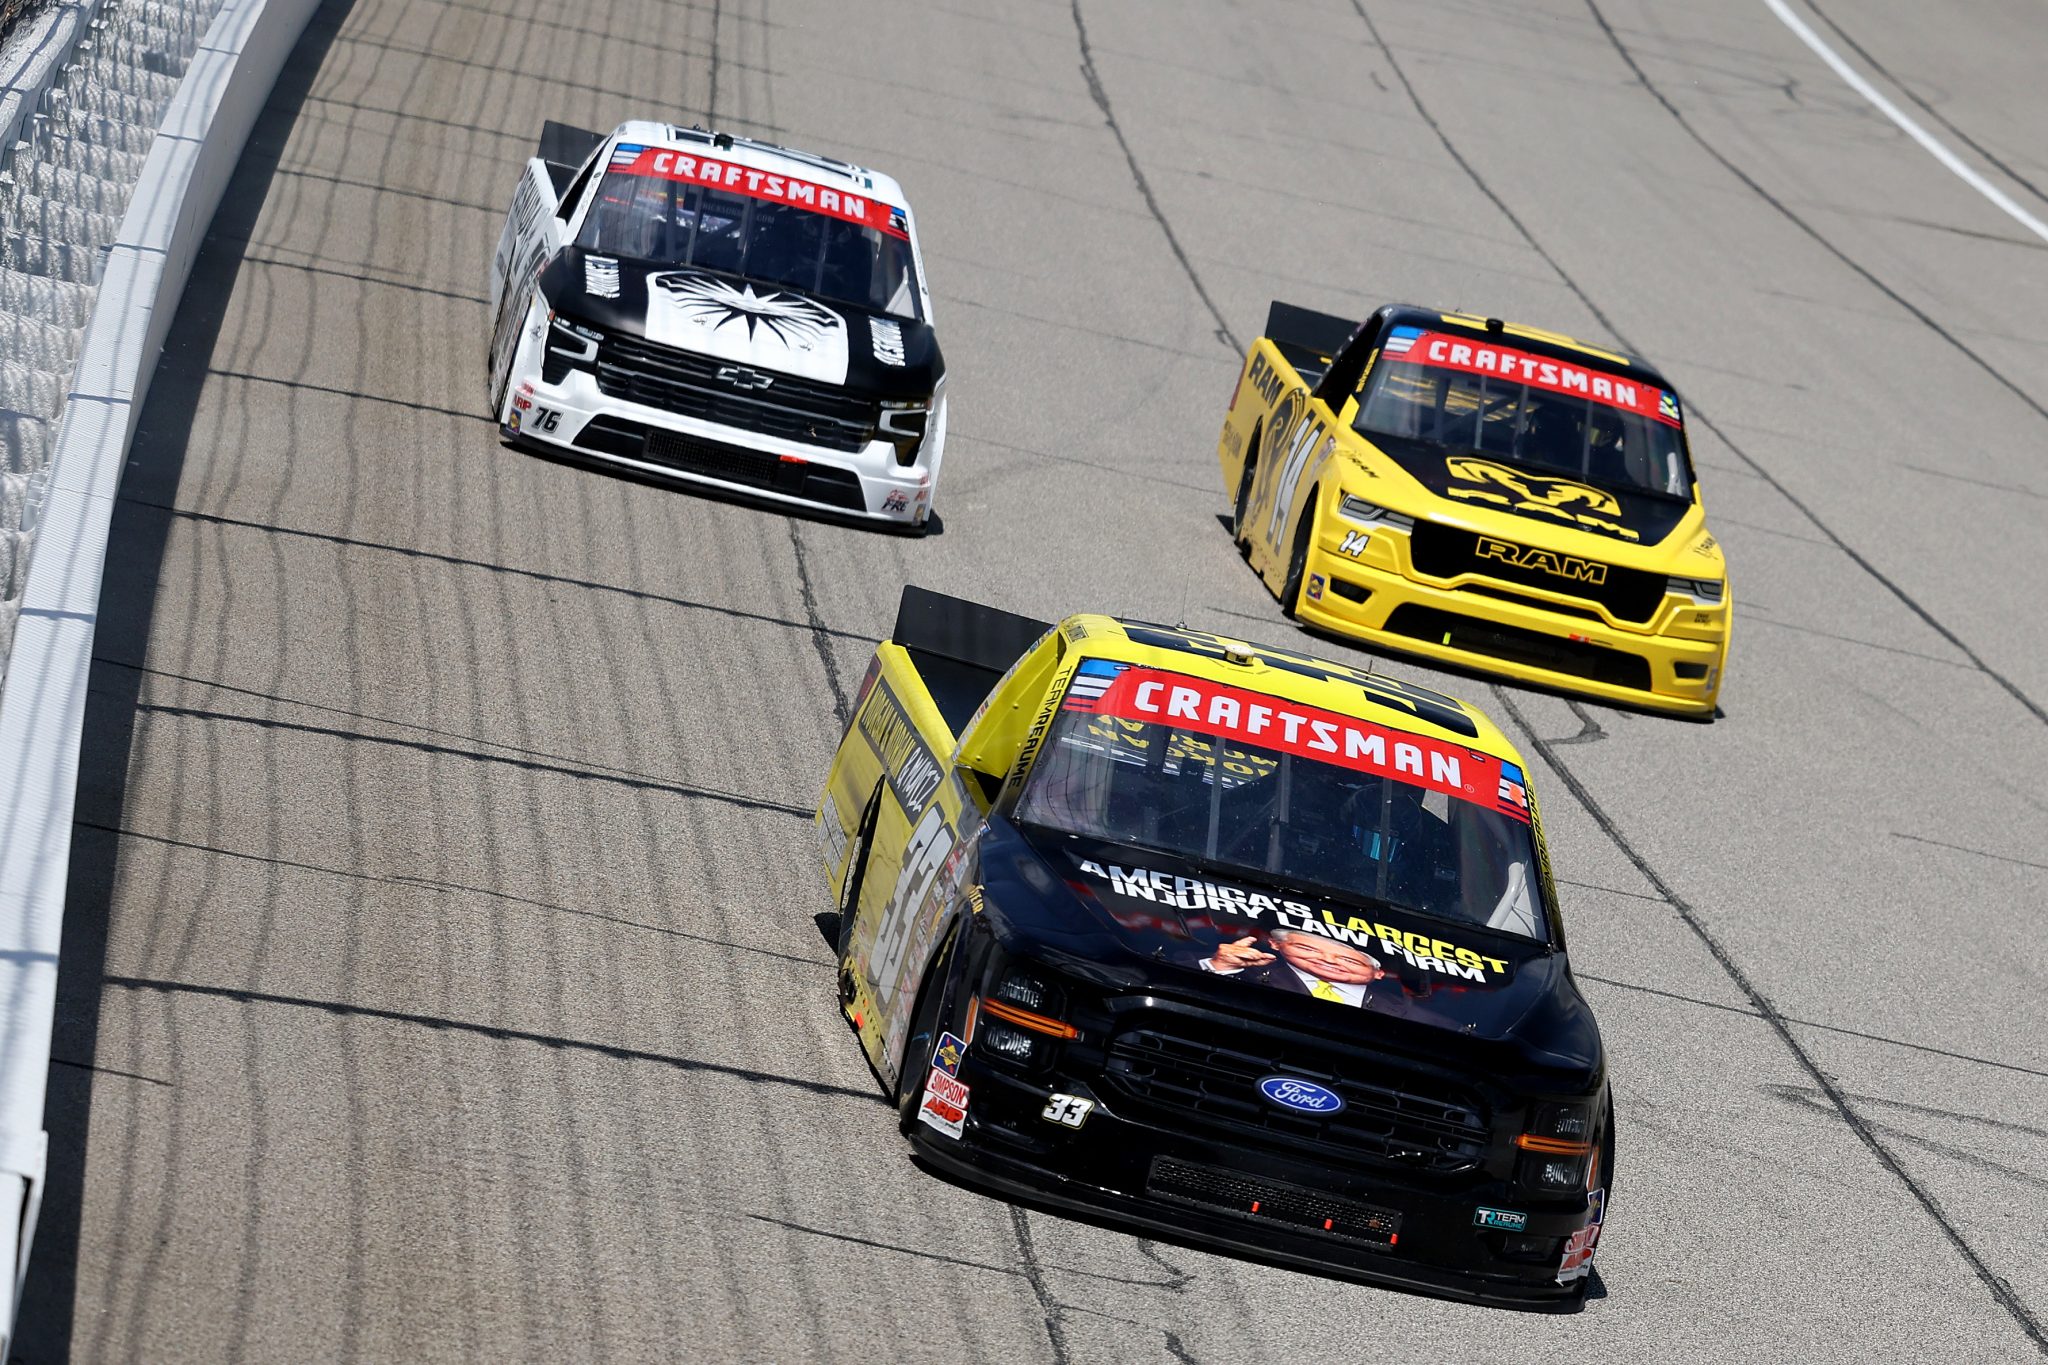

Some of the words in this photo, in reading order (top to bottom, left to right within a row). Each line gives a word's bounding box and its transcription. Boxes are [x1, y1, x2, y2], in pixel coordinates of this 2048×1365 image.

[653, 152, 866, 219] CRAFTSMAN
[1248, 350, 1285, 409] RAM
[1428, 340, 1637, 407] CRAFTSMAN
[531, 405, 564, 434] 76
[1266, 408, 1325, 557] 14
[1338, 530, 1371, 558] 14
[1475, 536, 1608, 585] RAM
[1134, 680, 1463, 789] CRAFTSMAN
[867, 801, 957, 1008] 33
[1080, 859, 1314, 919] AMERICA'S
[1321, 910, 1509, 974] LARGEST
[1111, 878, 1264, 920] INJURY
[1276, 911, 1369, 948] LAW
[1380, 937, 1487, 983] FIRM
[923, 1096, 964, 1124] ARP
[931, 1072, 966, 1105] SIMPSON
[1042, 1093, 1095, 1130] 33
[1274, 1081, 1328, 1109] Ford
[1496, 1211, 1526, 1224] TEAM
